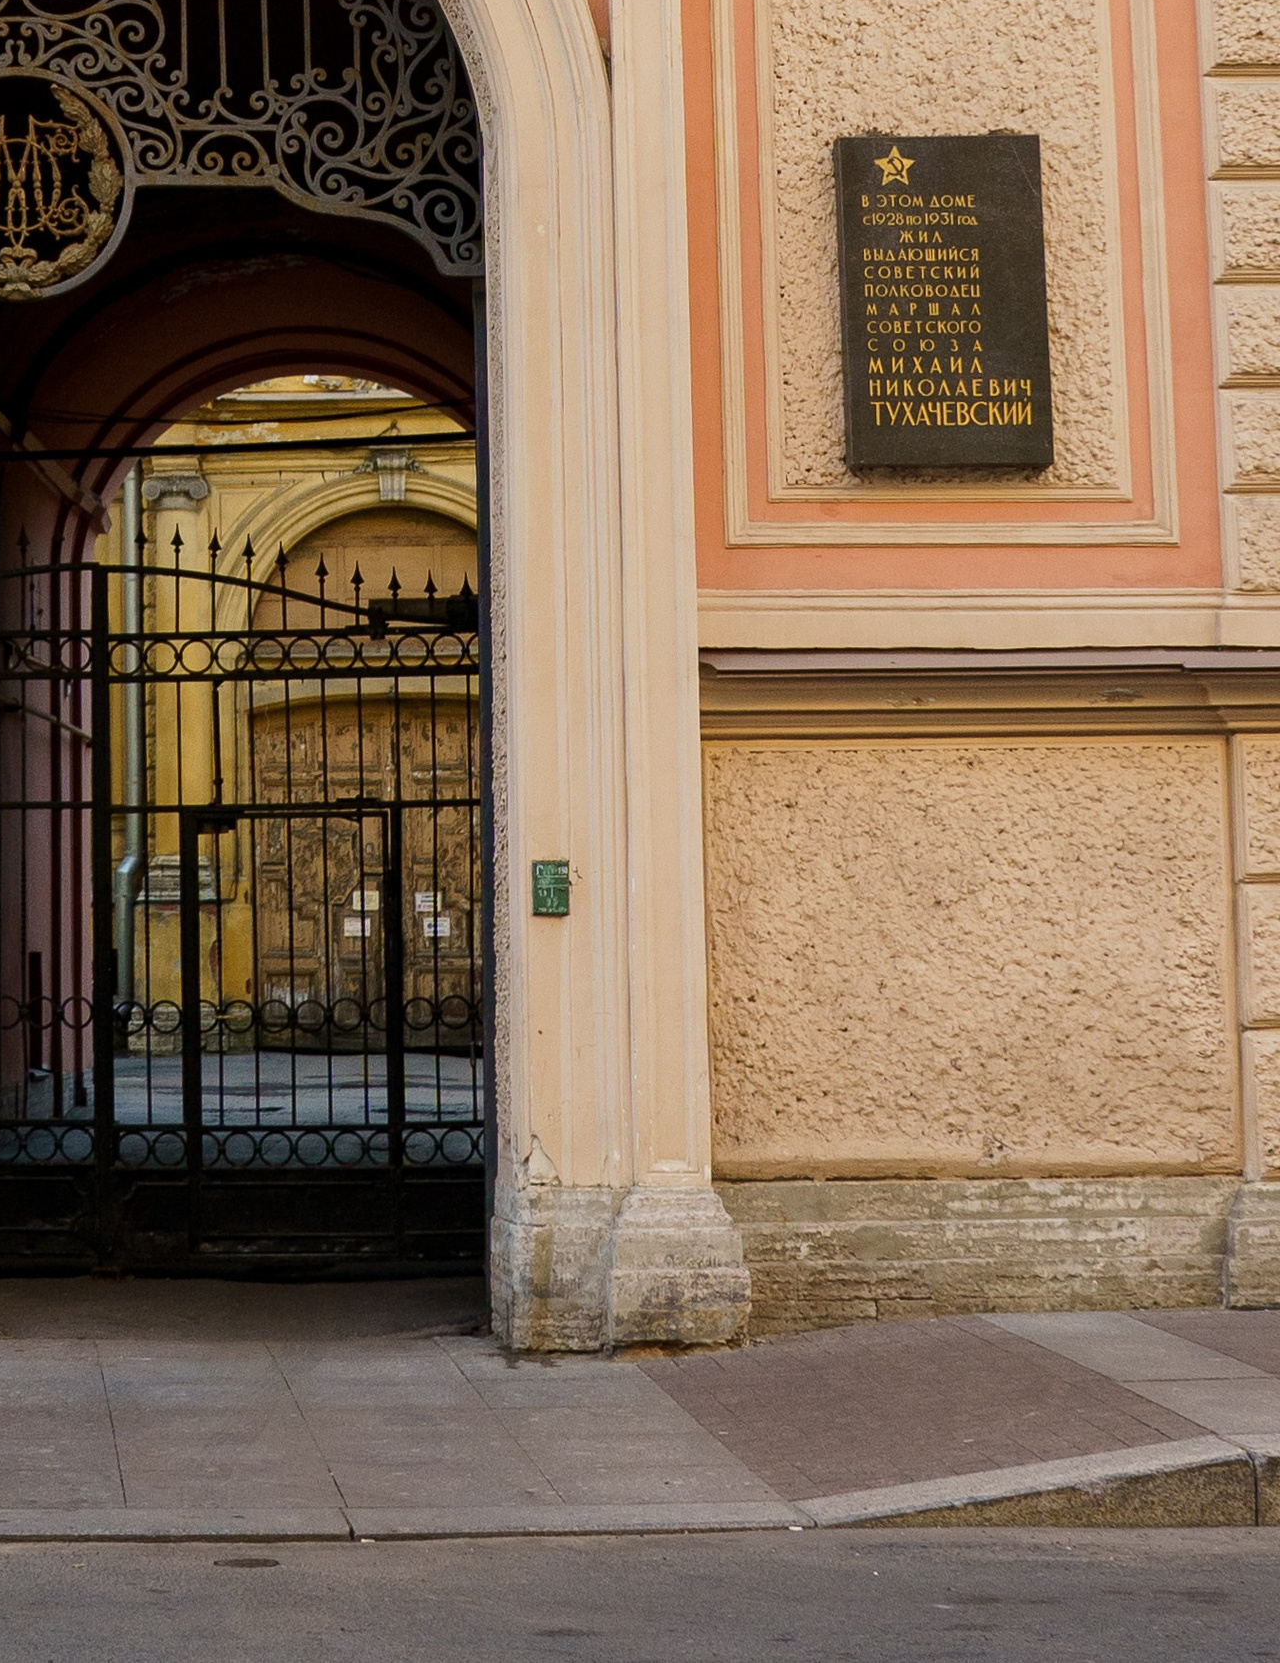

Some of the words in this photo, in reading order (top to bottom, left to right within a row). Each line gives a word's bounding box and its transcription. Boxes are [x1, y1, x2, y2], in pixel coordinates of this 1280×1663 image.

[861, 194, 870, 208] В
[876, 194, 924, 208] ЭТОМ
[929, 194, 976, 208] ДОМЕ
[924, 212, 954, 226] 1931
[957, 215, 978, 226] год
[899, 230, 942, 243] ЖИЛ
[864, 263, 980, 279] СОВЕТСКИЙ
[864, 283, 981, 298] ПОЛКОВОДЕЦ
[866, 302, 981, 316] МАРШАЛ
[866, 320, 982, 334] СОВЕТСКОГО
[867, 338, 983, 352] СОЮЗА
[868, 356, 983, 374] МИХАИЛ
[869, 378, 1032, 397] НИКОЛАЕВИЧ
[870, 397, 1032, 426] ТУХАЧЕВСКИЙ
